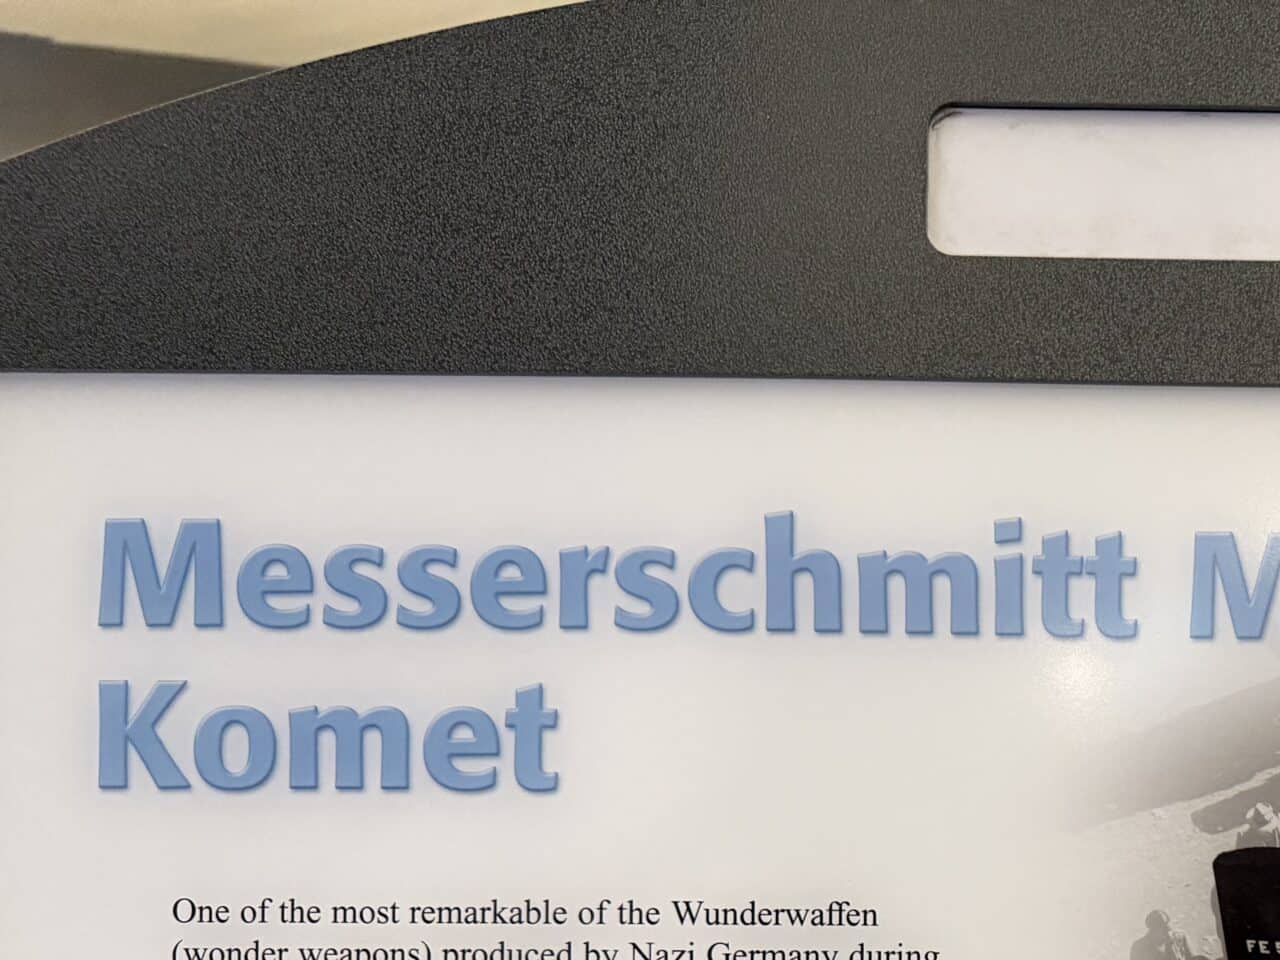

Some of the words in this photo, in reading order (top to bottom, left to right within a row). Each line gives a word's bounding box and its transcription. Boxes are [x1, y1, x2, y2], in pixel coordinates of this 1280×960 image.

[99, 512, 1140, 642] Messerschmitt
[98, 681, 560, 795] Komet
[172, 898, 230, 923] One
[240, 898, 273, 924] of
[278, 898, 321, 924] the
[331, 902, 400, 924] most
[409, 899, 567, 925] remarkable
[578, 899, 611, 925] of
[617, 899, 660, 925] the
[671, 900, 879, 927] Wunderwaffen
[1246, 939, 1271, 955] FE
